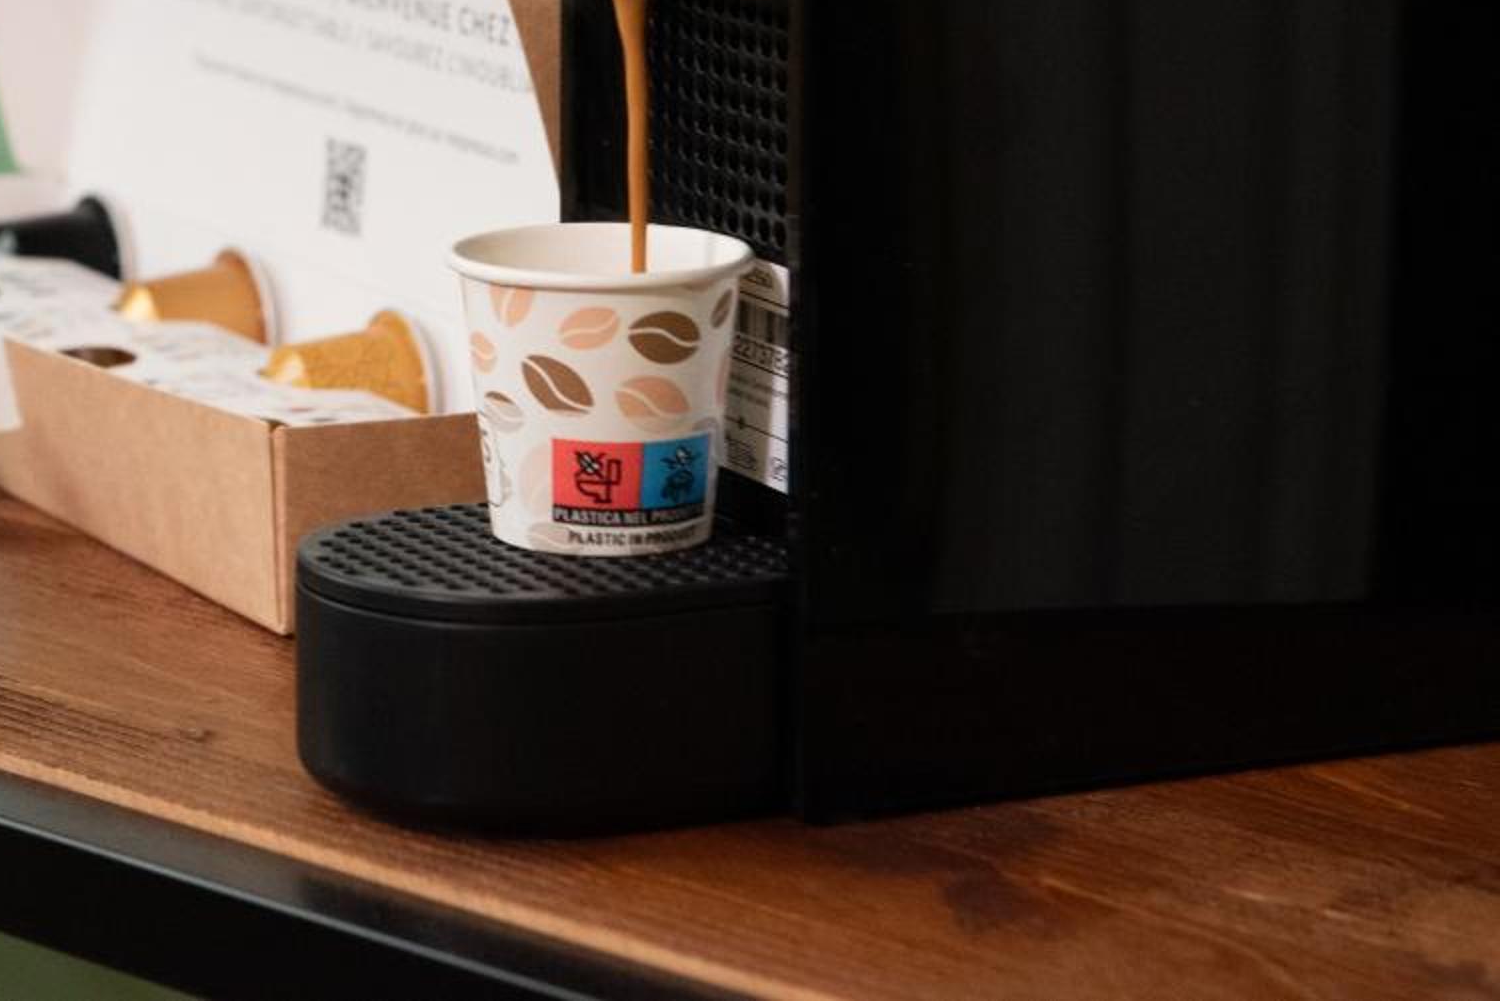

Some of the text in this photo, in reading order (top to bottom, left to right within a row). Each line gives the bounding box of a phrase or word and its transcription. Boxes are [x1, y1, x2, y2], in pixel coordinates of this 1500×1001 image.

[459, 7, 511, 48] CHEZ
[555, 507, 622, 526] PLASTICA
[568, 528, 627, 549] PLASTIC
[630, 533, 645, 548] IN
